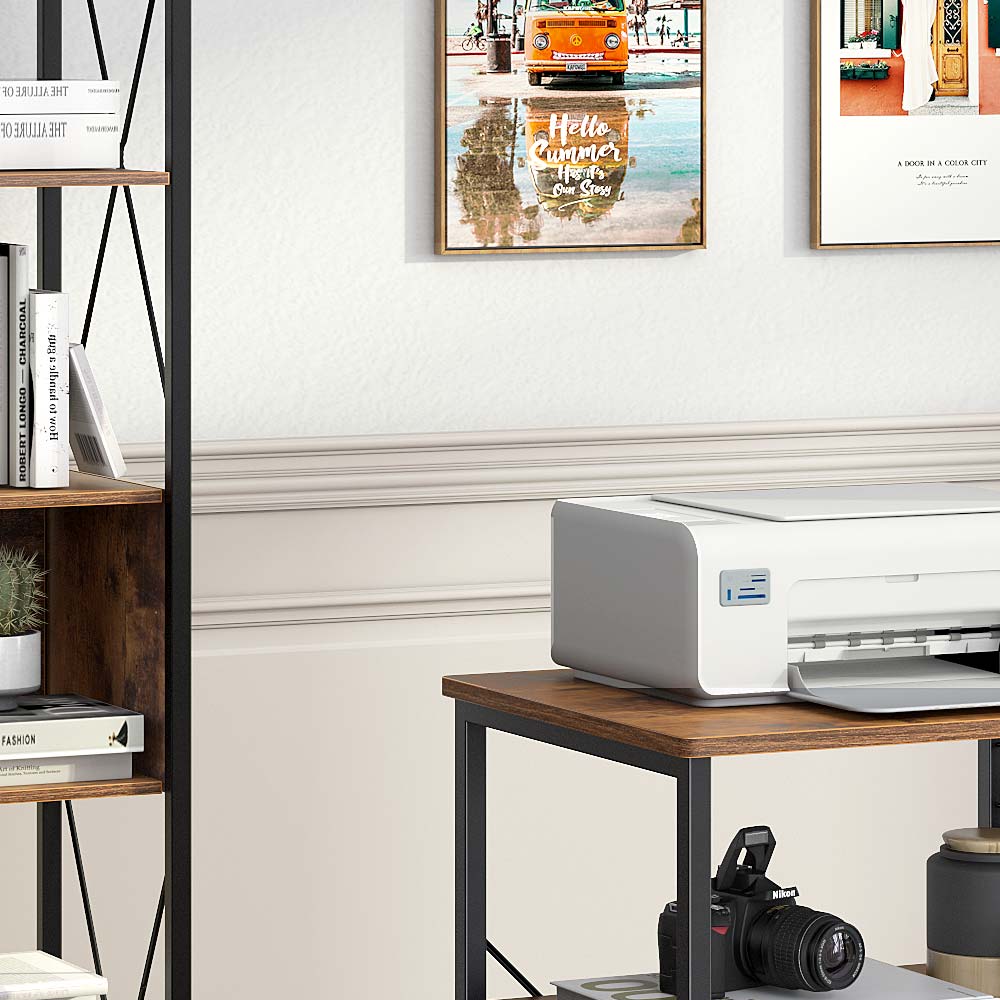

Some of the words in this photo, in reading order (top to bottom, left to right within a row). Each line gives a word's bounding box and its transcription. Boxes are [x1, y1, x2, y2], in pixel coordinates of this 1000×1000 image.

[549, 113, 611, 146] Hello
[528, 139, 622, 170] Summer
[19, 298, 27, 365] CHARCOAL
[19, 387, 27, 429] LONGO
[19, 431, 27, 482] ROBERT
[1, 734, 36, 747] FASHION
[772, 889, 796, 900] Nikon
